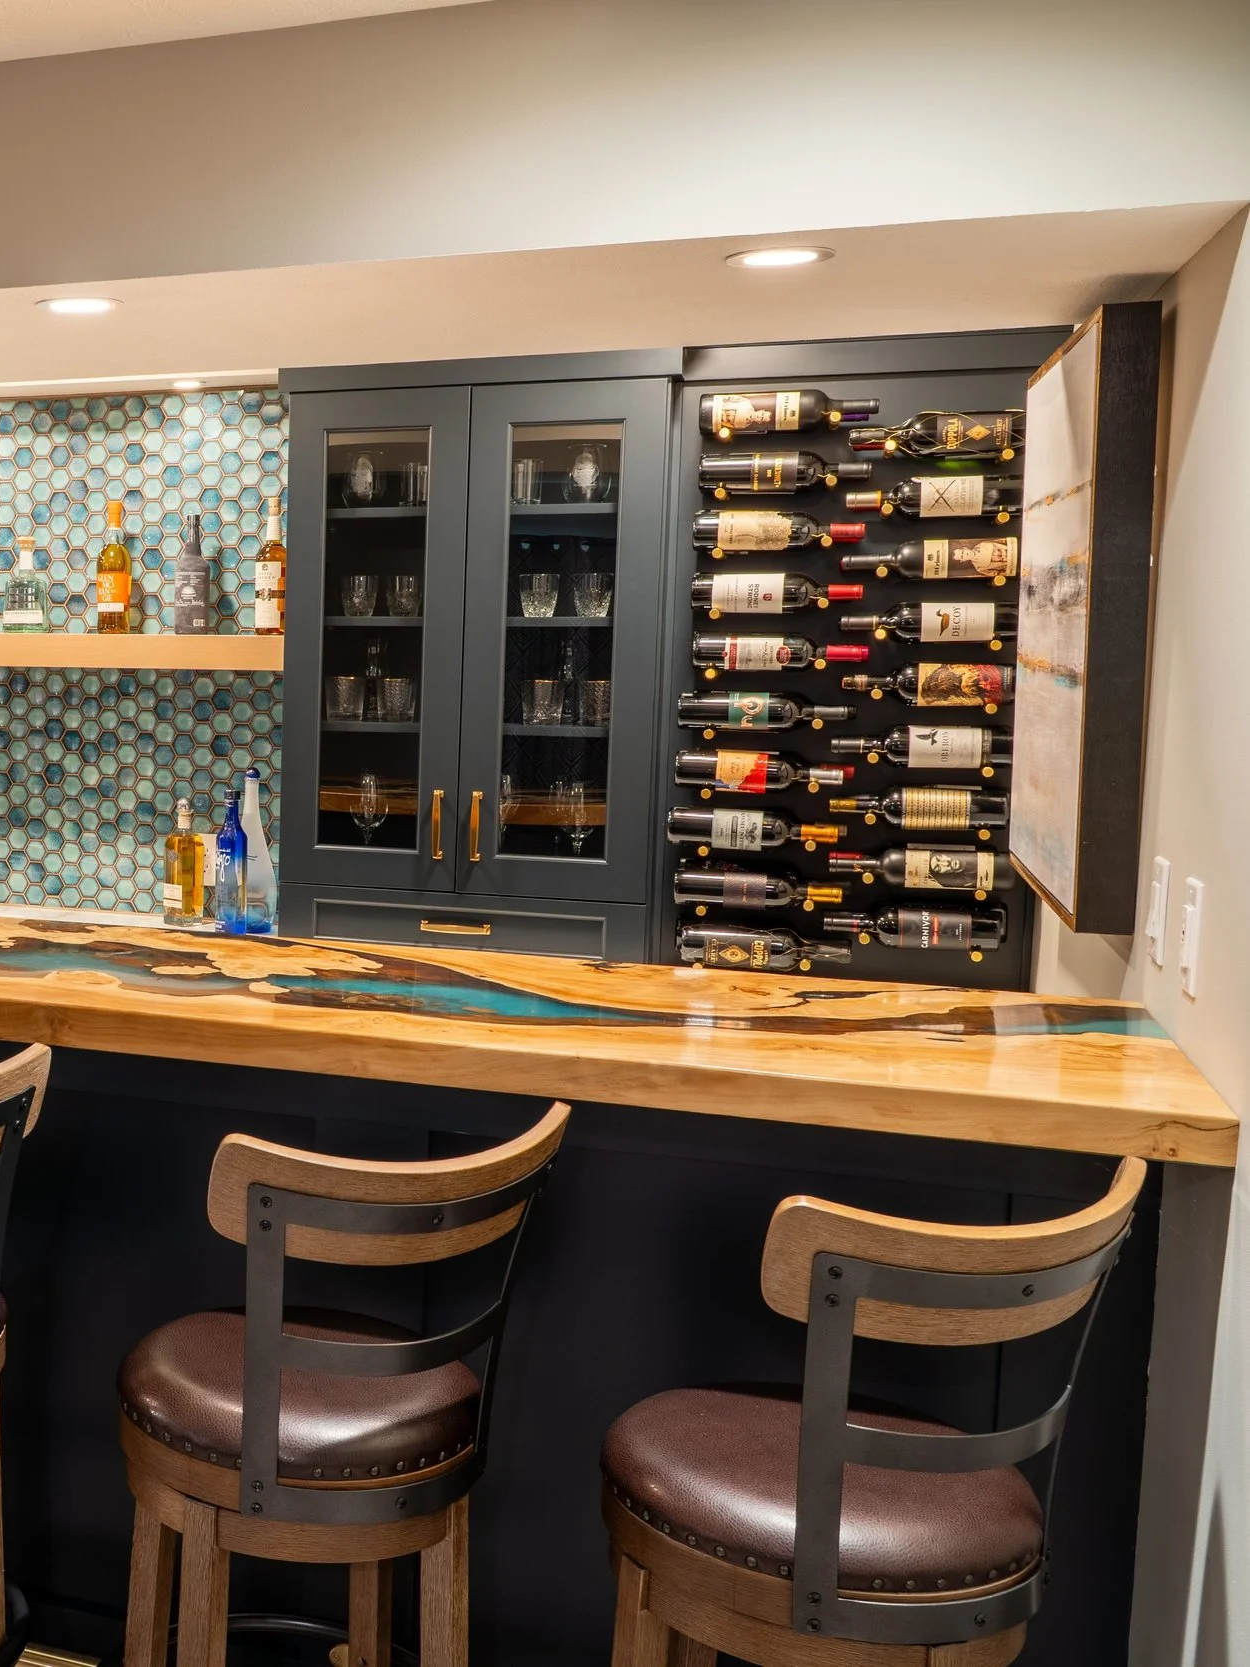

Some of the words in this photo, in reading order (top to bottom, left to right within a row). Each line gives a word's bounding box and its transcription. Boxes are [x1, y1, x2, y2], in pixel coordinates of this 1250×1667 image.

[946, 418, 959, 450] COPPOLA
[746, 583, 754, 609] STRONG
[951, 606, 961, 637] DECOY
[940, 731, 949, 763] OBERON
[920, 910, 931, 949] CARNIVOR
